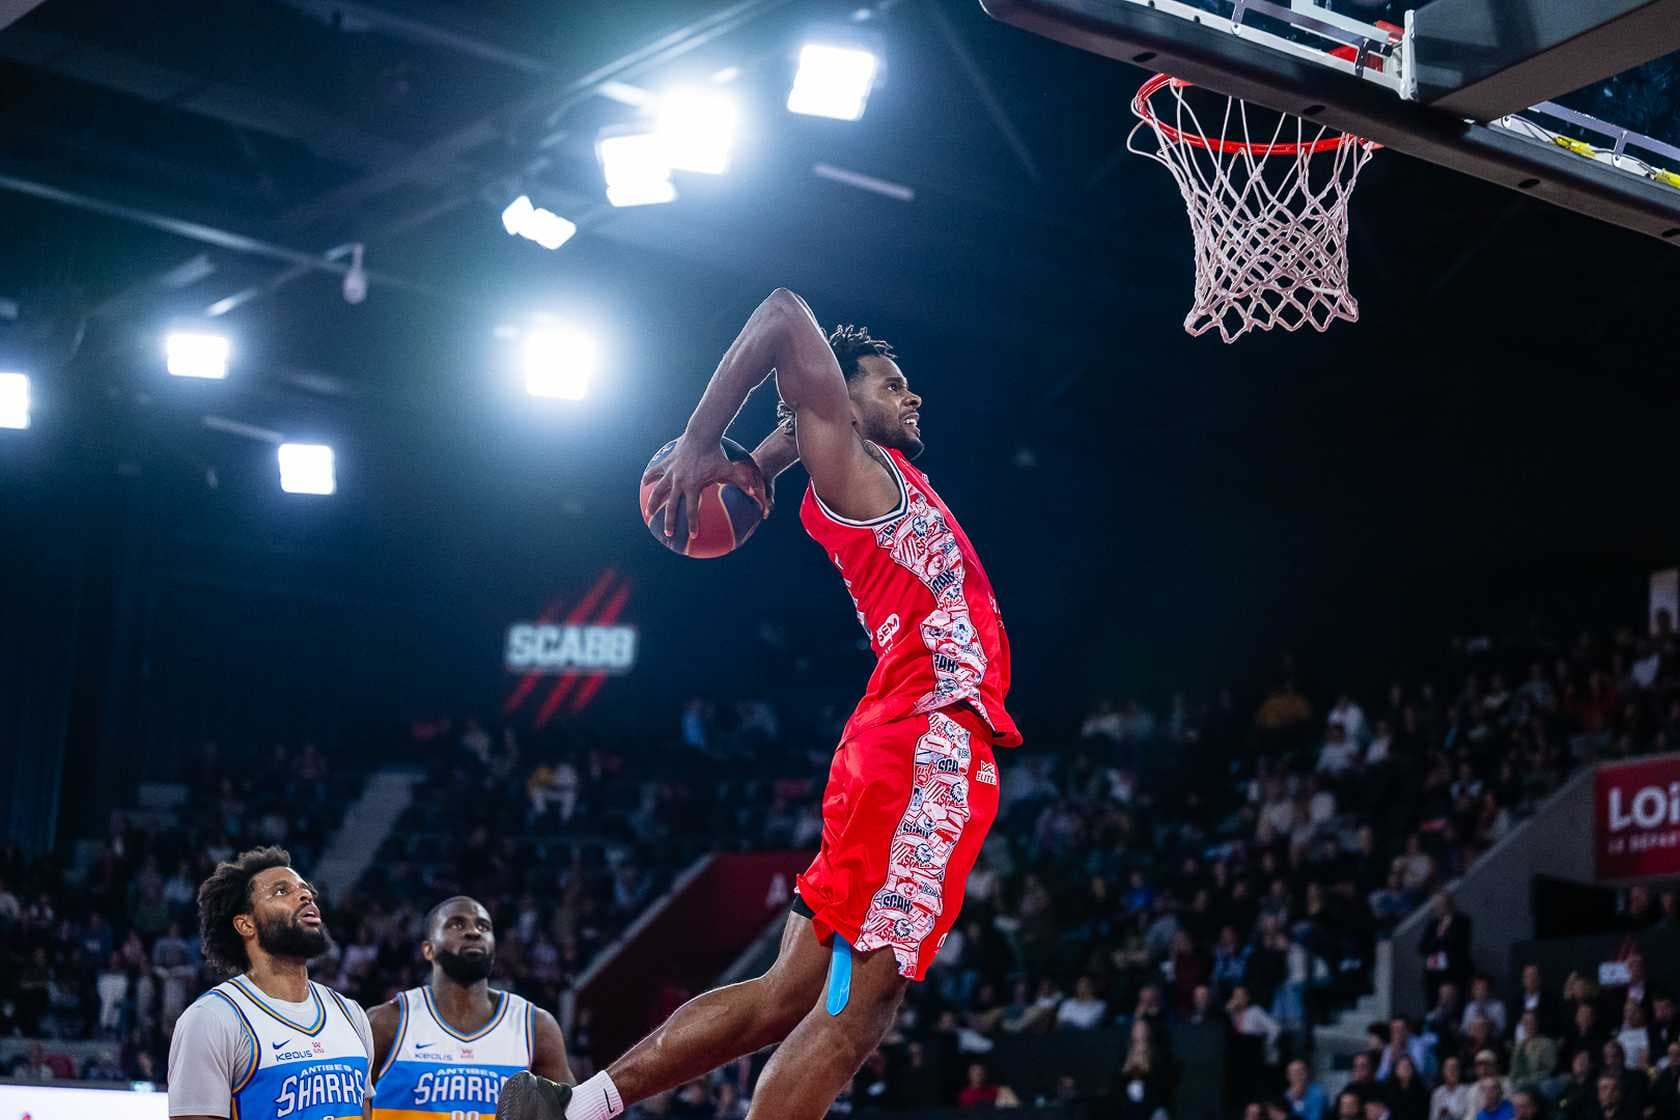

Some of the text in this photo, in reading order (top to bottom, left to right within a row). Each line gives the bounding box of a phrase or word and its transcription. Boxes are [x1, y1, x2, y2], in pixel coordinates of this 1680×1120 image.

[506, 623, 637, 669] SCABB
[977, 772, 995, 784] ELITE
[301, 1064, 352, 1078] ANTIBES
[437, 1067, 498, 1077] ANTIBES
[275, 1069, 365, 1118] SHARKS
